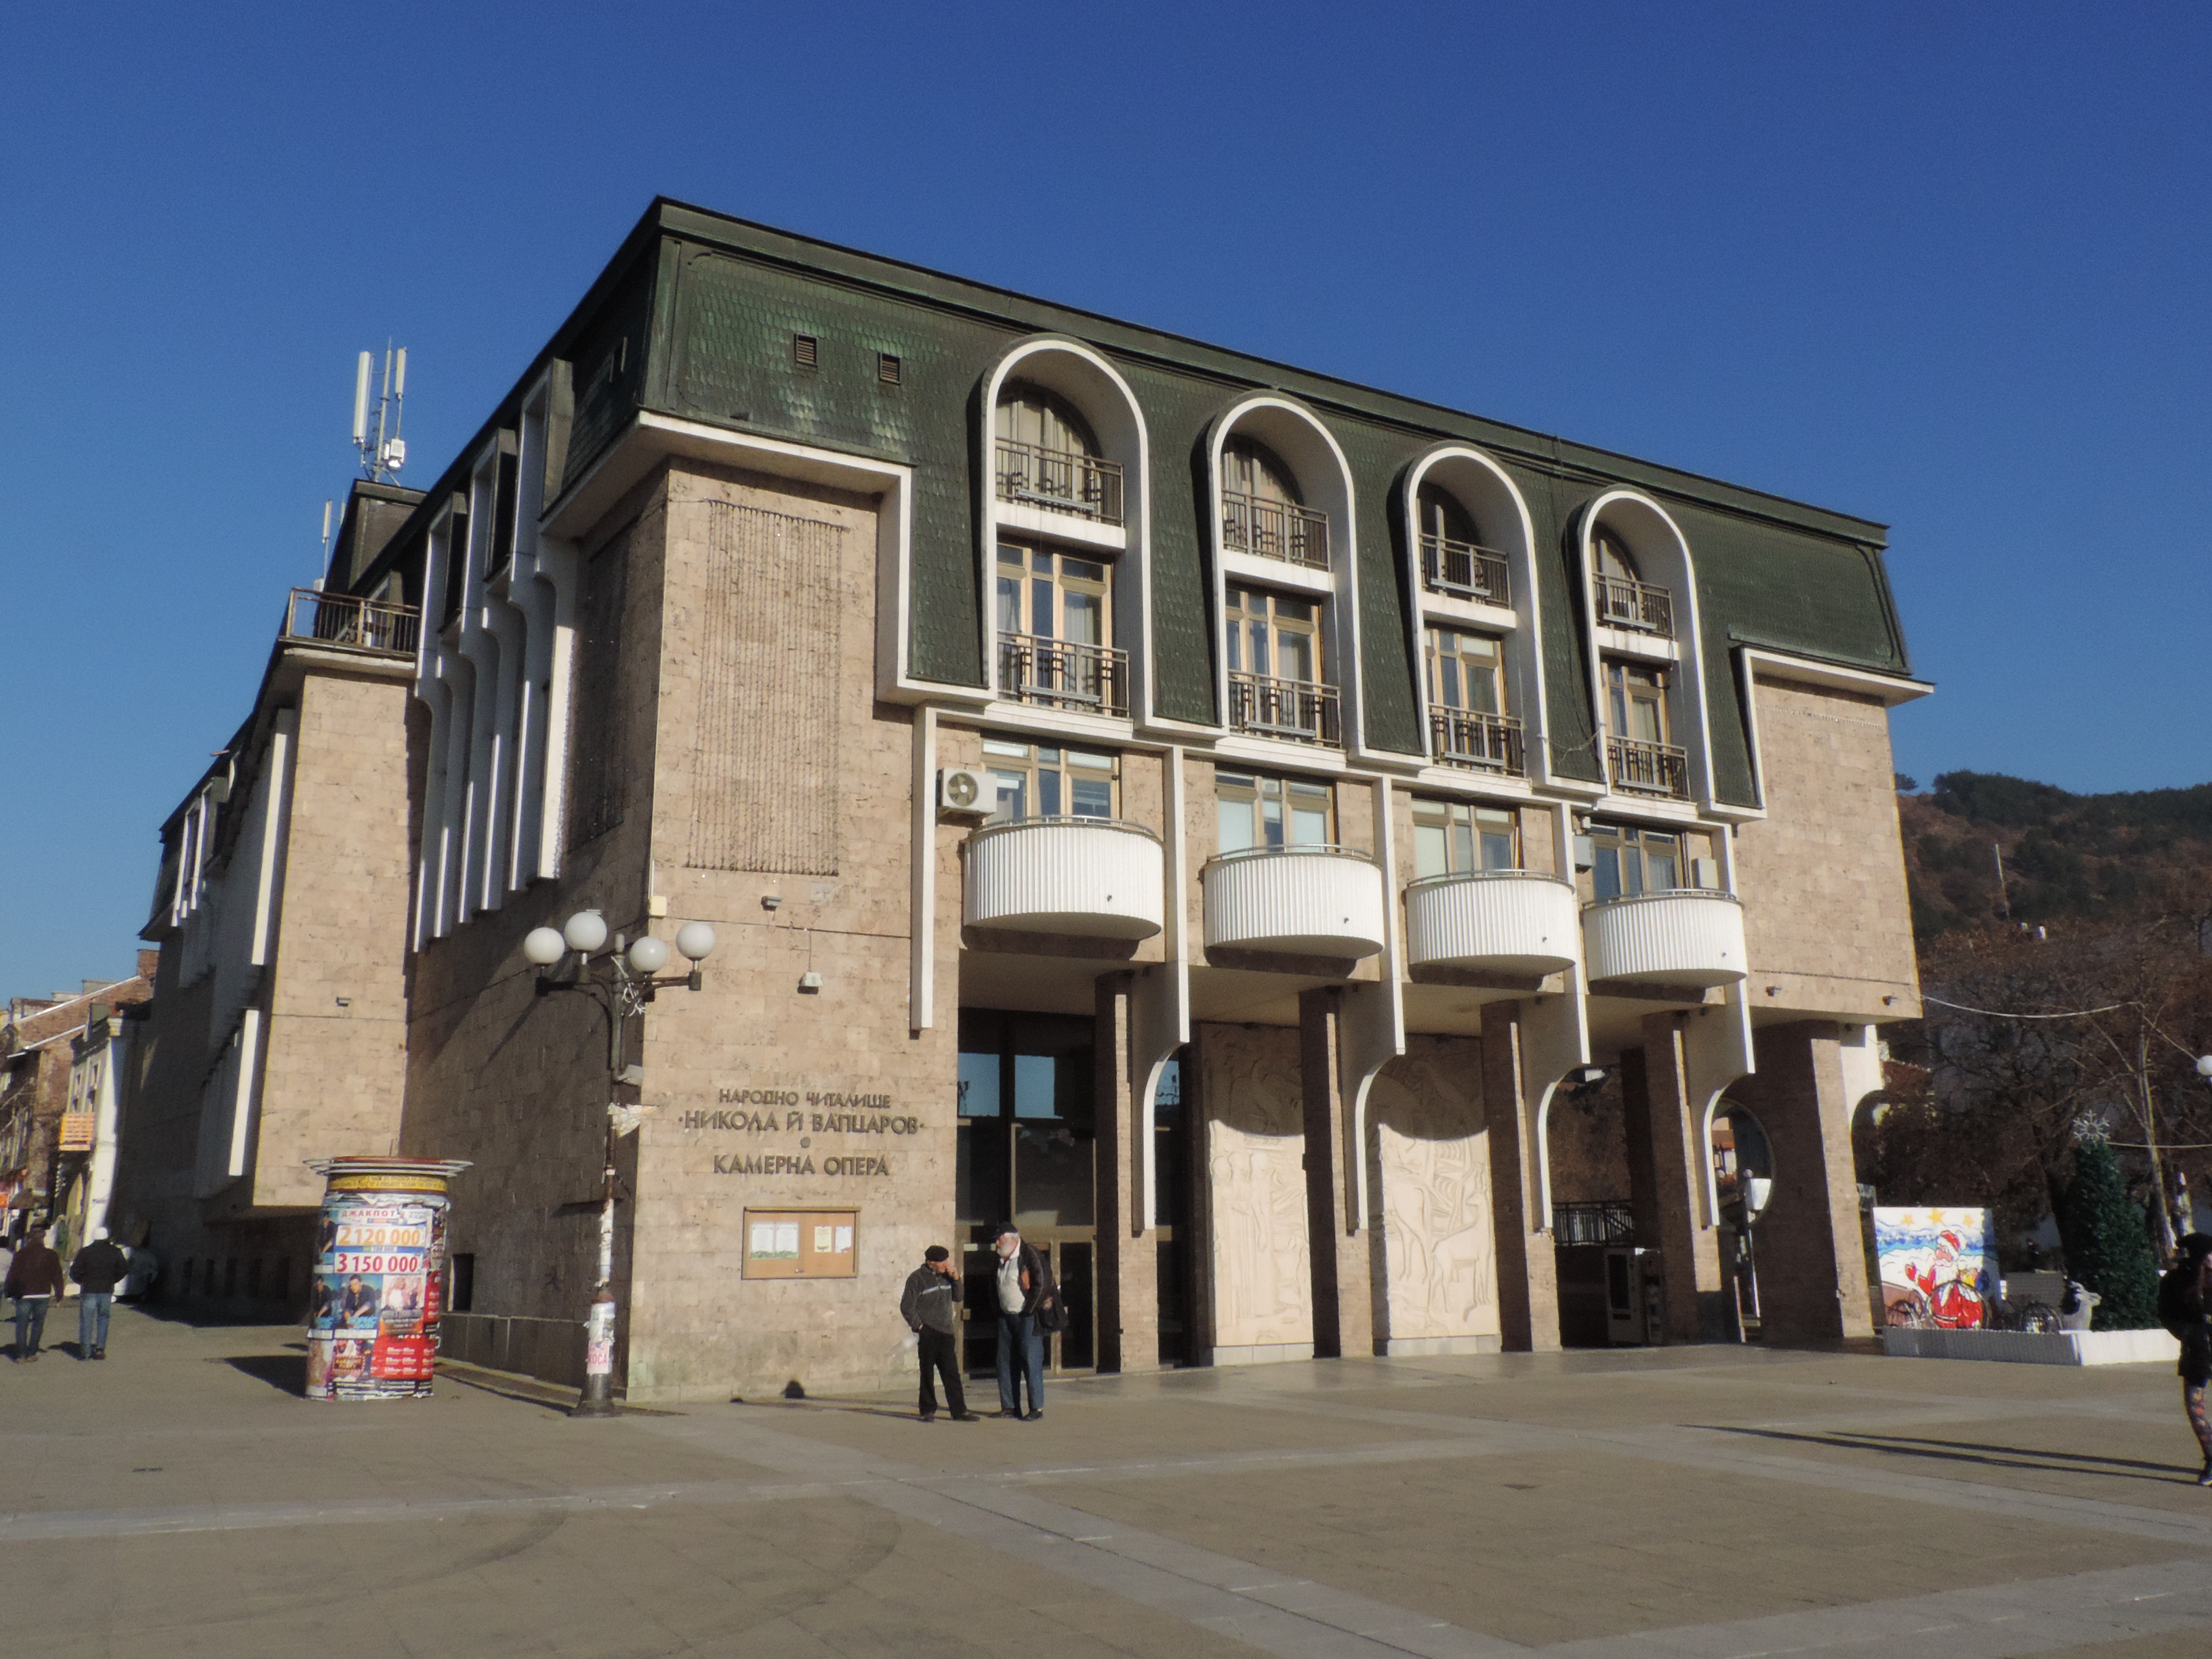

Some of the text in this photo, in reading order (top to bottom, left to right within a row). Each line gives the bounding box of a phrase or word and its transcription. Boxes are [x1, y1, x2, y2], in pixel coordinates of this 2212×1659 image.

[719, 1088, 800, 1106] НАРОДНО
[685, 1110, 780, 1131] НИКОЛА
[812, 1113, 918, 1135] ВАПЦАРОВ
[714, 1154, 890, 1176] КАМЕРНА ОПЕРА
[342, 1210, 396, 1218] ДЖАКПОТ
[339, 1225, 421, 1246] 2 120 000
[336, 1252, 348, 1273] 3
[352, 1255, 384, 1273] 150
[387, 1255, 418, 1273] 000
